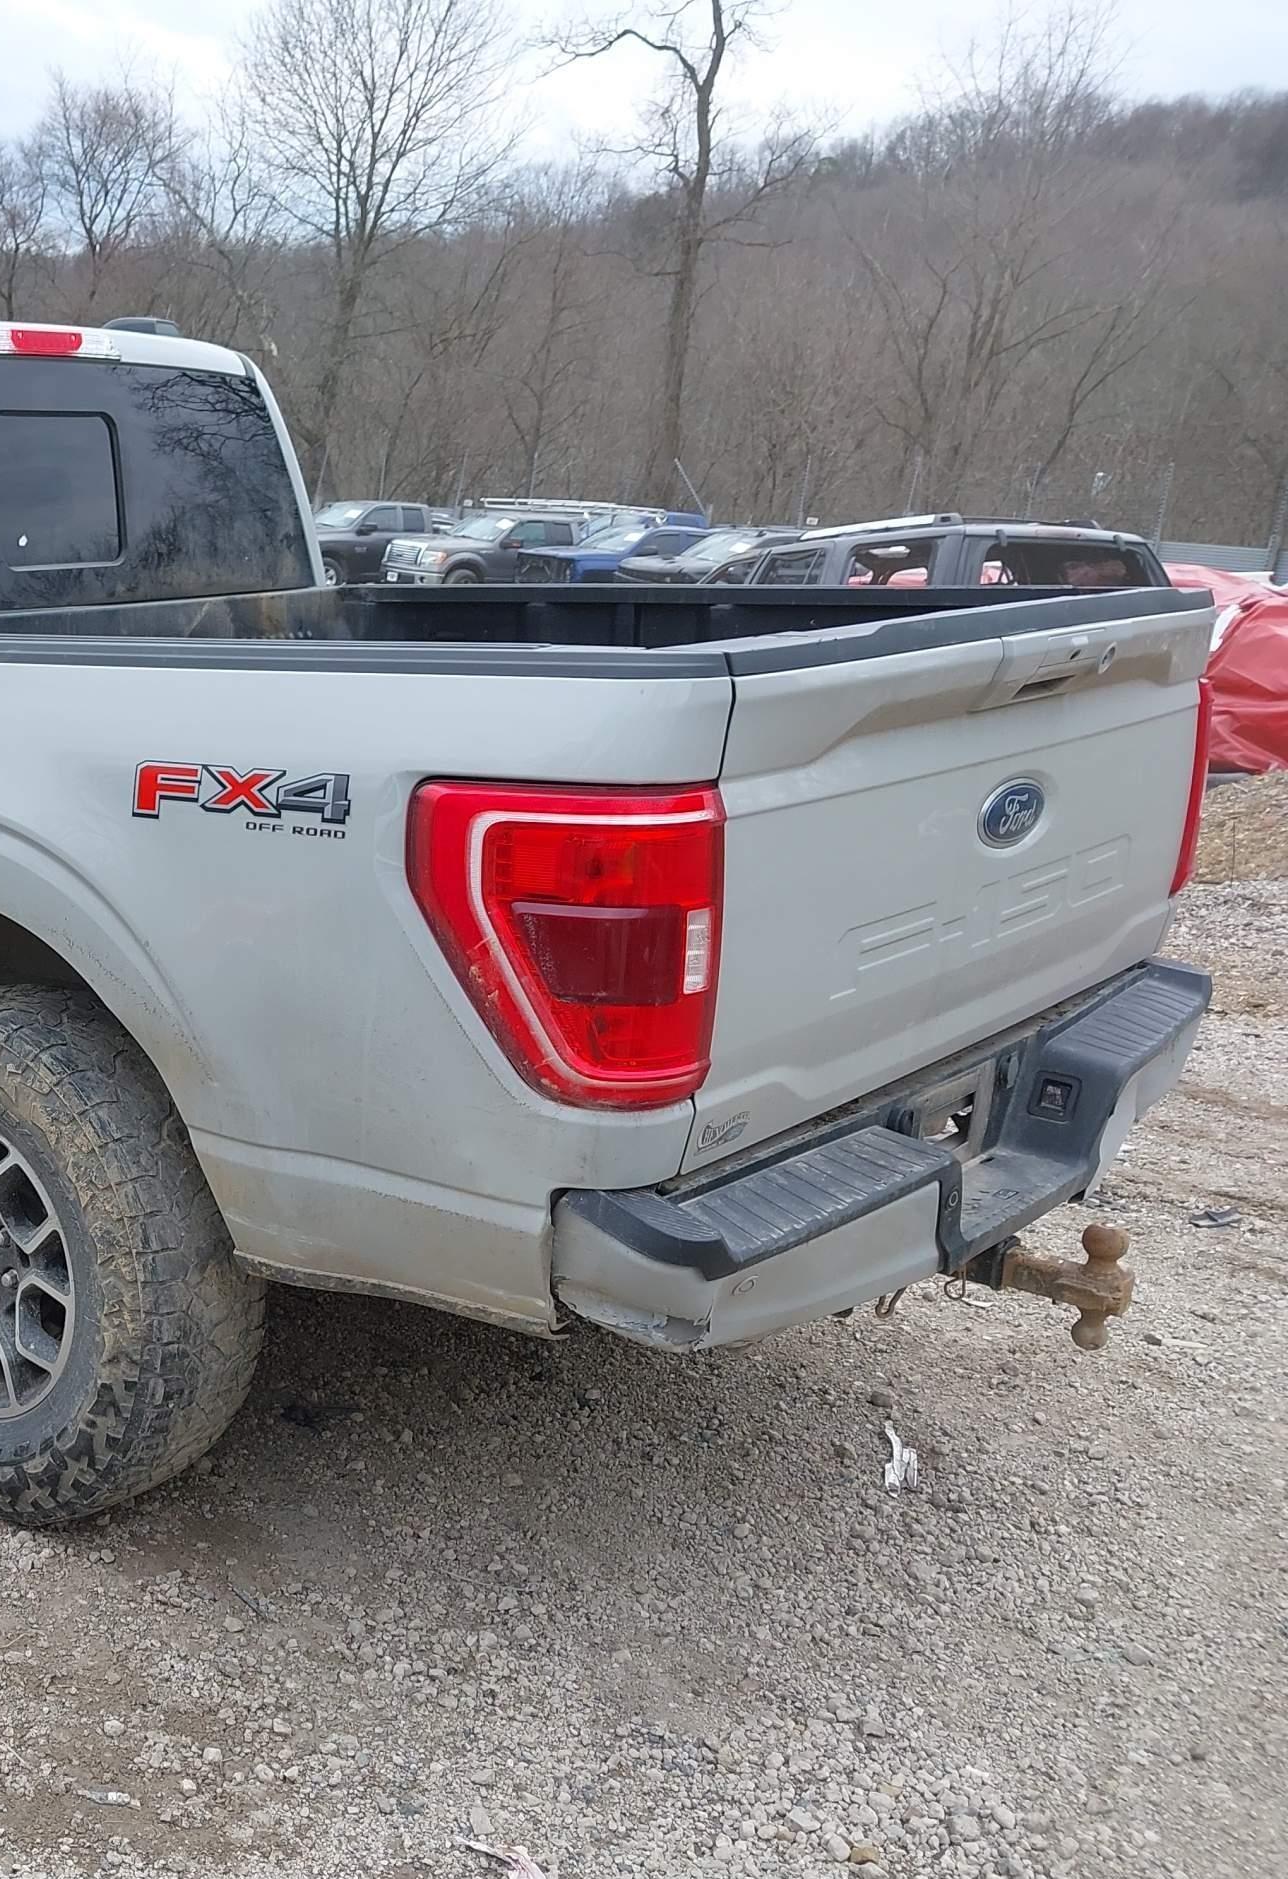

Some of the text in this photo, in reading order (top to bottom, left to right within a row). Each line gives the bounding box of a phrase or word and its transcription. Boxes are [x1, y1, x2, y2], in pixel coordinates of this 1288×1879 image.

[132, 760, 351, 824] FX4
[245, 821, 346, 839] OFF ROAD
[1000, 793, 1037, 834] Ford
